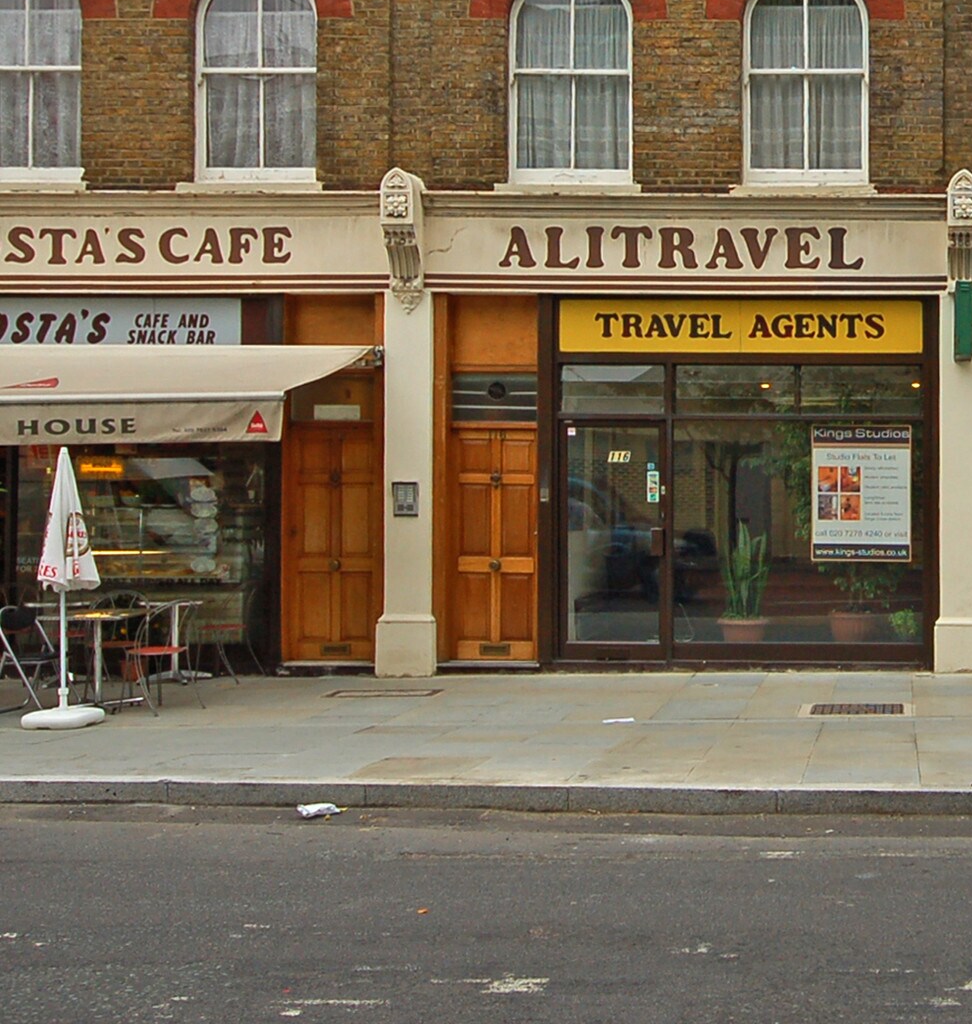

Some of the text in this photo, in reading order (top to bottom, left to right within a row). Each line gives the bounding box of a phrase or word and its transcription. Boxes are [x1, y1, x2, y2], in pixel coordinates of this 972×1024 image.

[158, 226, 292, 264] CAFE
[499, 225, 865, 270] ALITRAVEL
[135, 313, 209, 328] CAFE AND
[594, 312, 885, 339] TRAVEL AGENTS
[127, 330, 215, 344] SNACK BAR
[17, 418, 137, 435] HOUSE
[814, 428, 910, 440] Kings Studios
[609, 451, 630, 462] 116
[826, 453, 850, 461] Studio
[852, 453, 871, 461] Flats
[815, 548, 907, 557] www.kings-studios.co.uk
